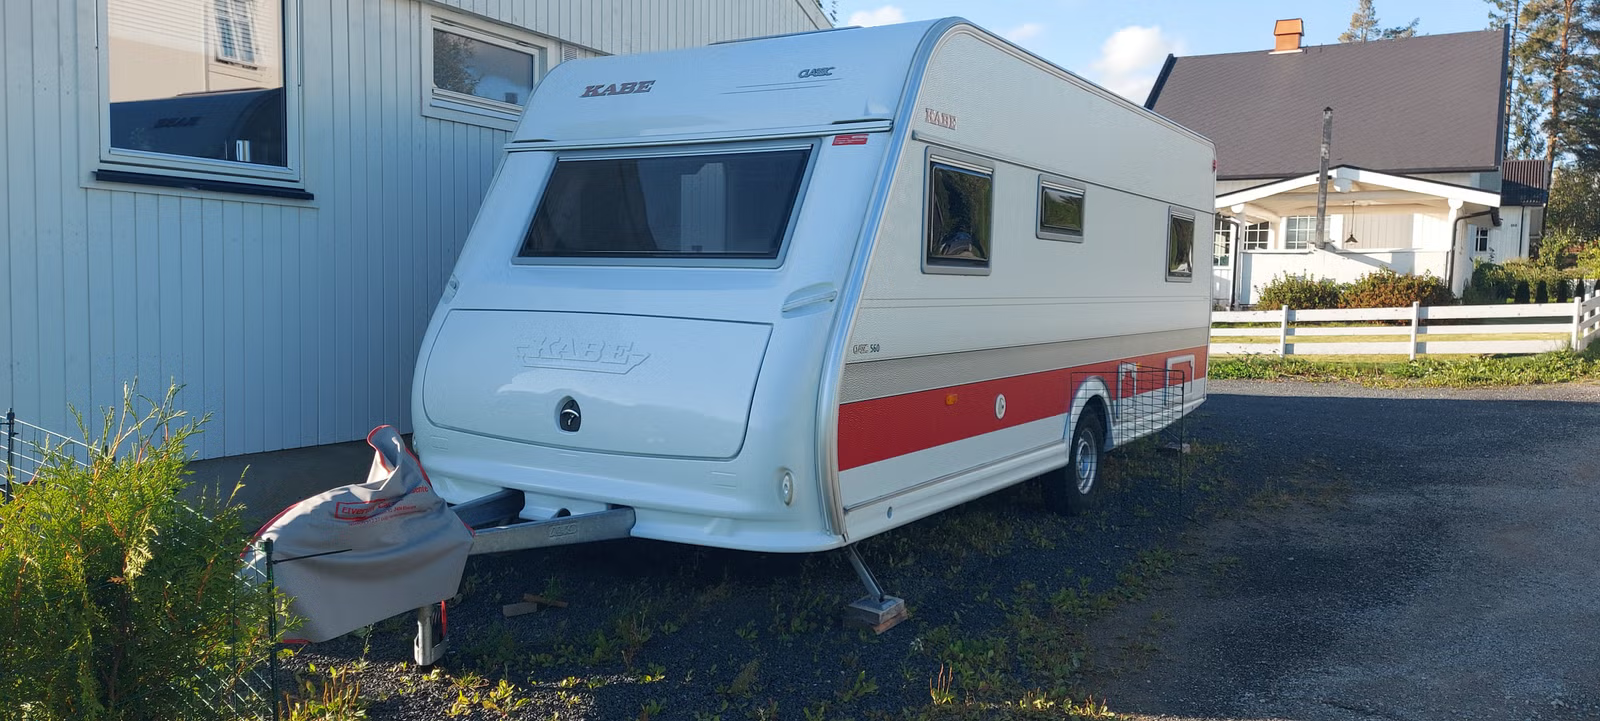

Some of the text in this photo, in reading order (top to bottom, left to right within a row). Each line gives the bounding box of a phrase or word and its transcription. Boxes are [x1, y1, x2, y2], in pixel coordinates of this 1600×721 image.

[579, 80, 656, 98] KABE
[925, 107, 957, 131] KABE
[529, 337, 634, 365] KABE
